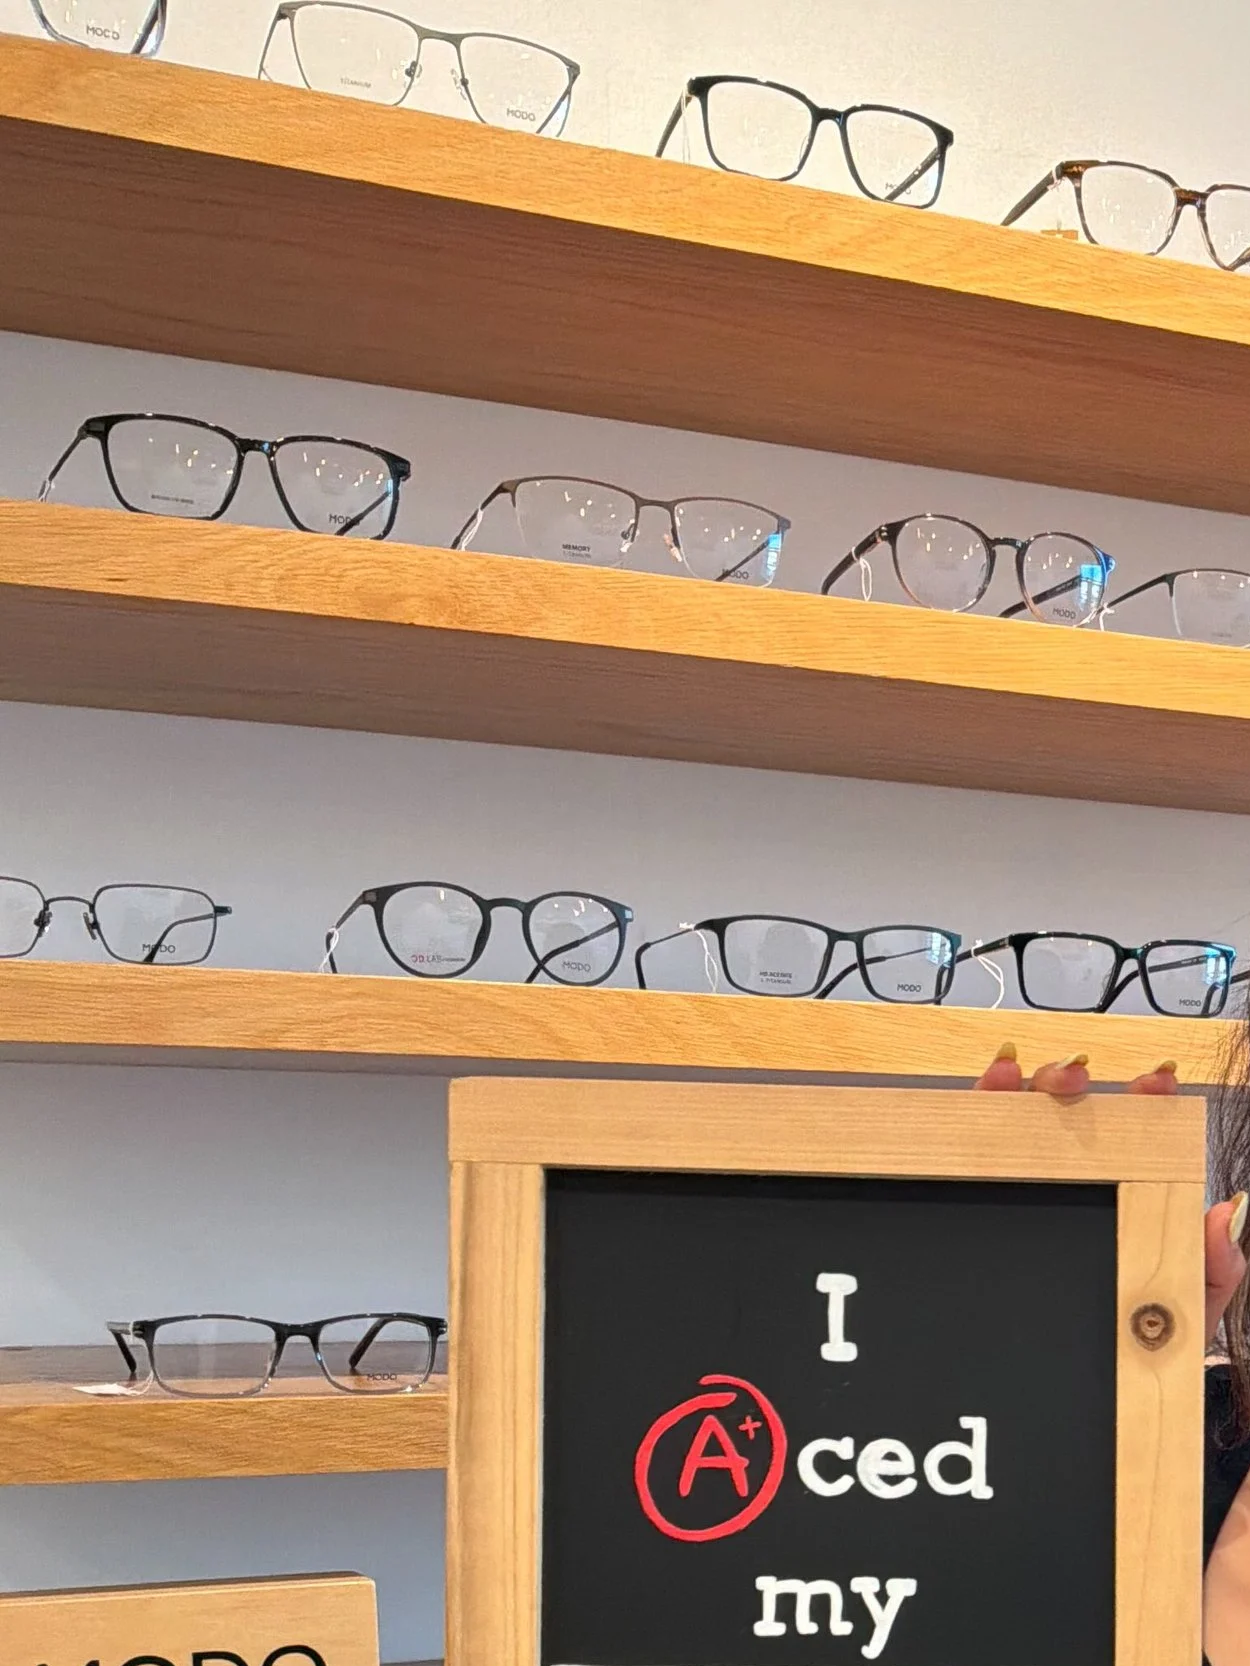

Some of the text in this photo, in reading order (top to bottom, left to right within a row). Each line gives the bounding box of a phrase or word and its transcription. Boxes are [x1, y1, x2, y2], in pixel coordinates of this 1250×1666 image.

[506, 108, 536, 122] MODO
[329, 513, 359, 526] MOD
[562, 543, 590, 552] MEMORY
[1052, 607, 1077, 620] MODO
[562, 961, 591, 973] MODO
[897, 984, 922, 993] MODO
[1179, 999, 1202, 1007] MODO
[816, 1273, 857, 1362] I
[366, 1373, 398, 1381] MODO
[754, 1576, 917, 1659] my
